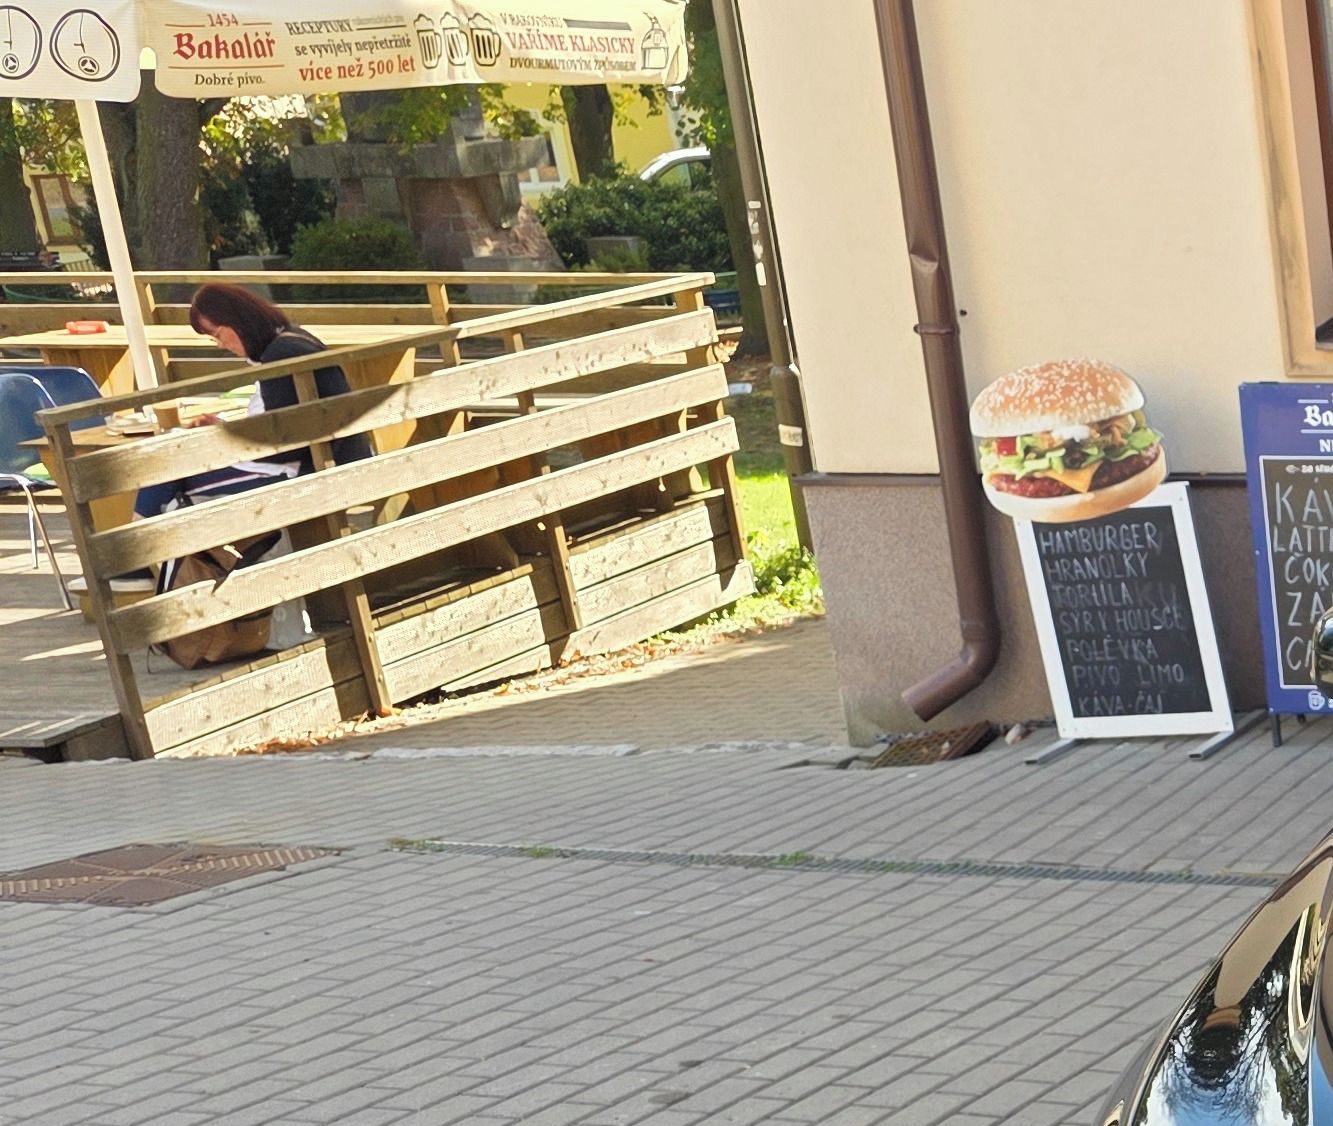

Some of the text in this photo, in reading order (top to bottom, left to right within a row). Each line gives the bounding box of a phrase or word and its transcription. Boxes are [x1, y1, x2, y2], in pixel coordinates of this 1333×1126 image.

[207, 13, 239, 28] 1454
[284, 19, 354, 36] RECEPTURY
[173, 31, 276, 60] Bakalář
[295, 34, 413, 58] se vyvíjely nepřetržitě
[505, 28, 636, 55] VAŘÍME KLASICKY
[194, 72, 234, 86] Dobré
[299, 54, 416, 82] více než 500 let
[1039, 522, 1160, 554] HAMBURGER
[1045, 551, 1148, 582] HRANOLKY
[1066, 634, 1159, 663] POLÉVKA
[1072, 663, 1185, 688] PIVO LIMO
